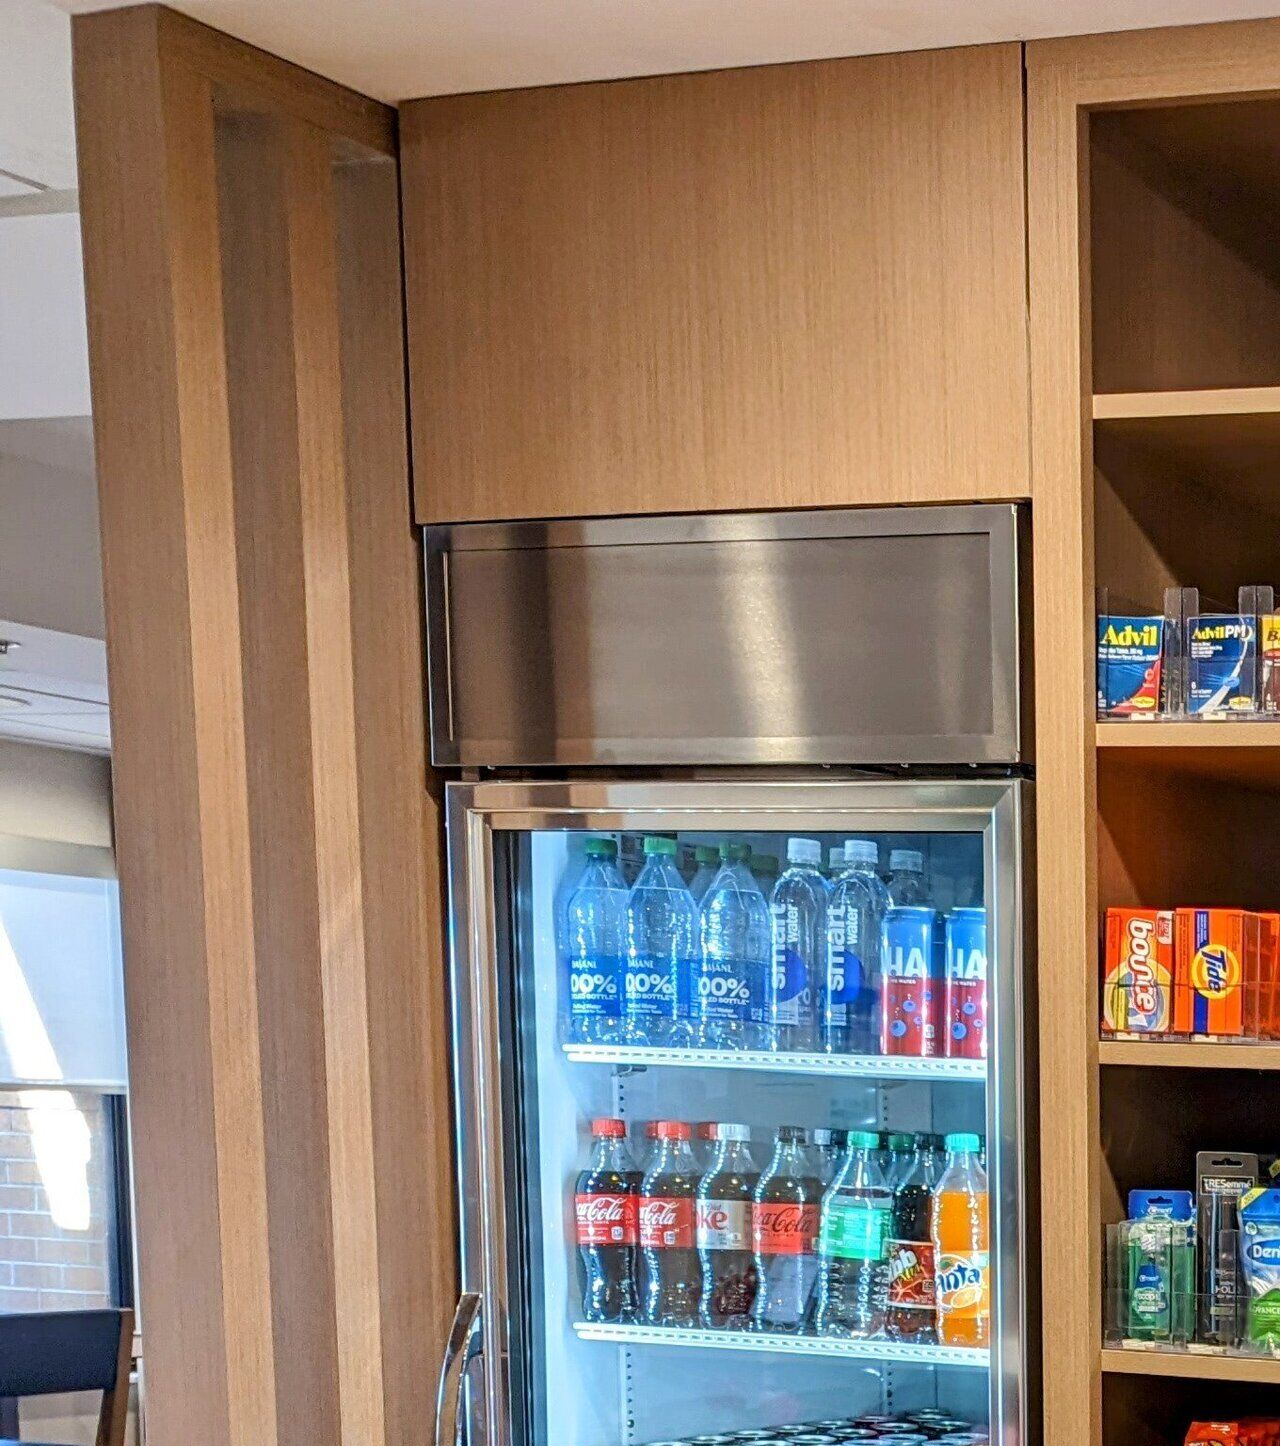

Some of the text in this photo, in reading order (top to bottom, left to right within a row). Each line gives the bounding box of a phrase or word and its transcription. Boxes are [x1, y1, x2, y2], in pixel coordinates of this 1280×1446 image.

[1102, 625, 1158, 647] Advil
[787, 902, 799, 943] water
[846, 904, 859, 945] water
[771, 903, 786, 991] smart
[826, 905, 844, 991] smart
[1129, 918, 1157, 1015] bounce
[1201, 949, 1227, 993] Tide
